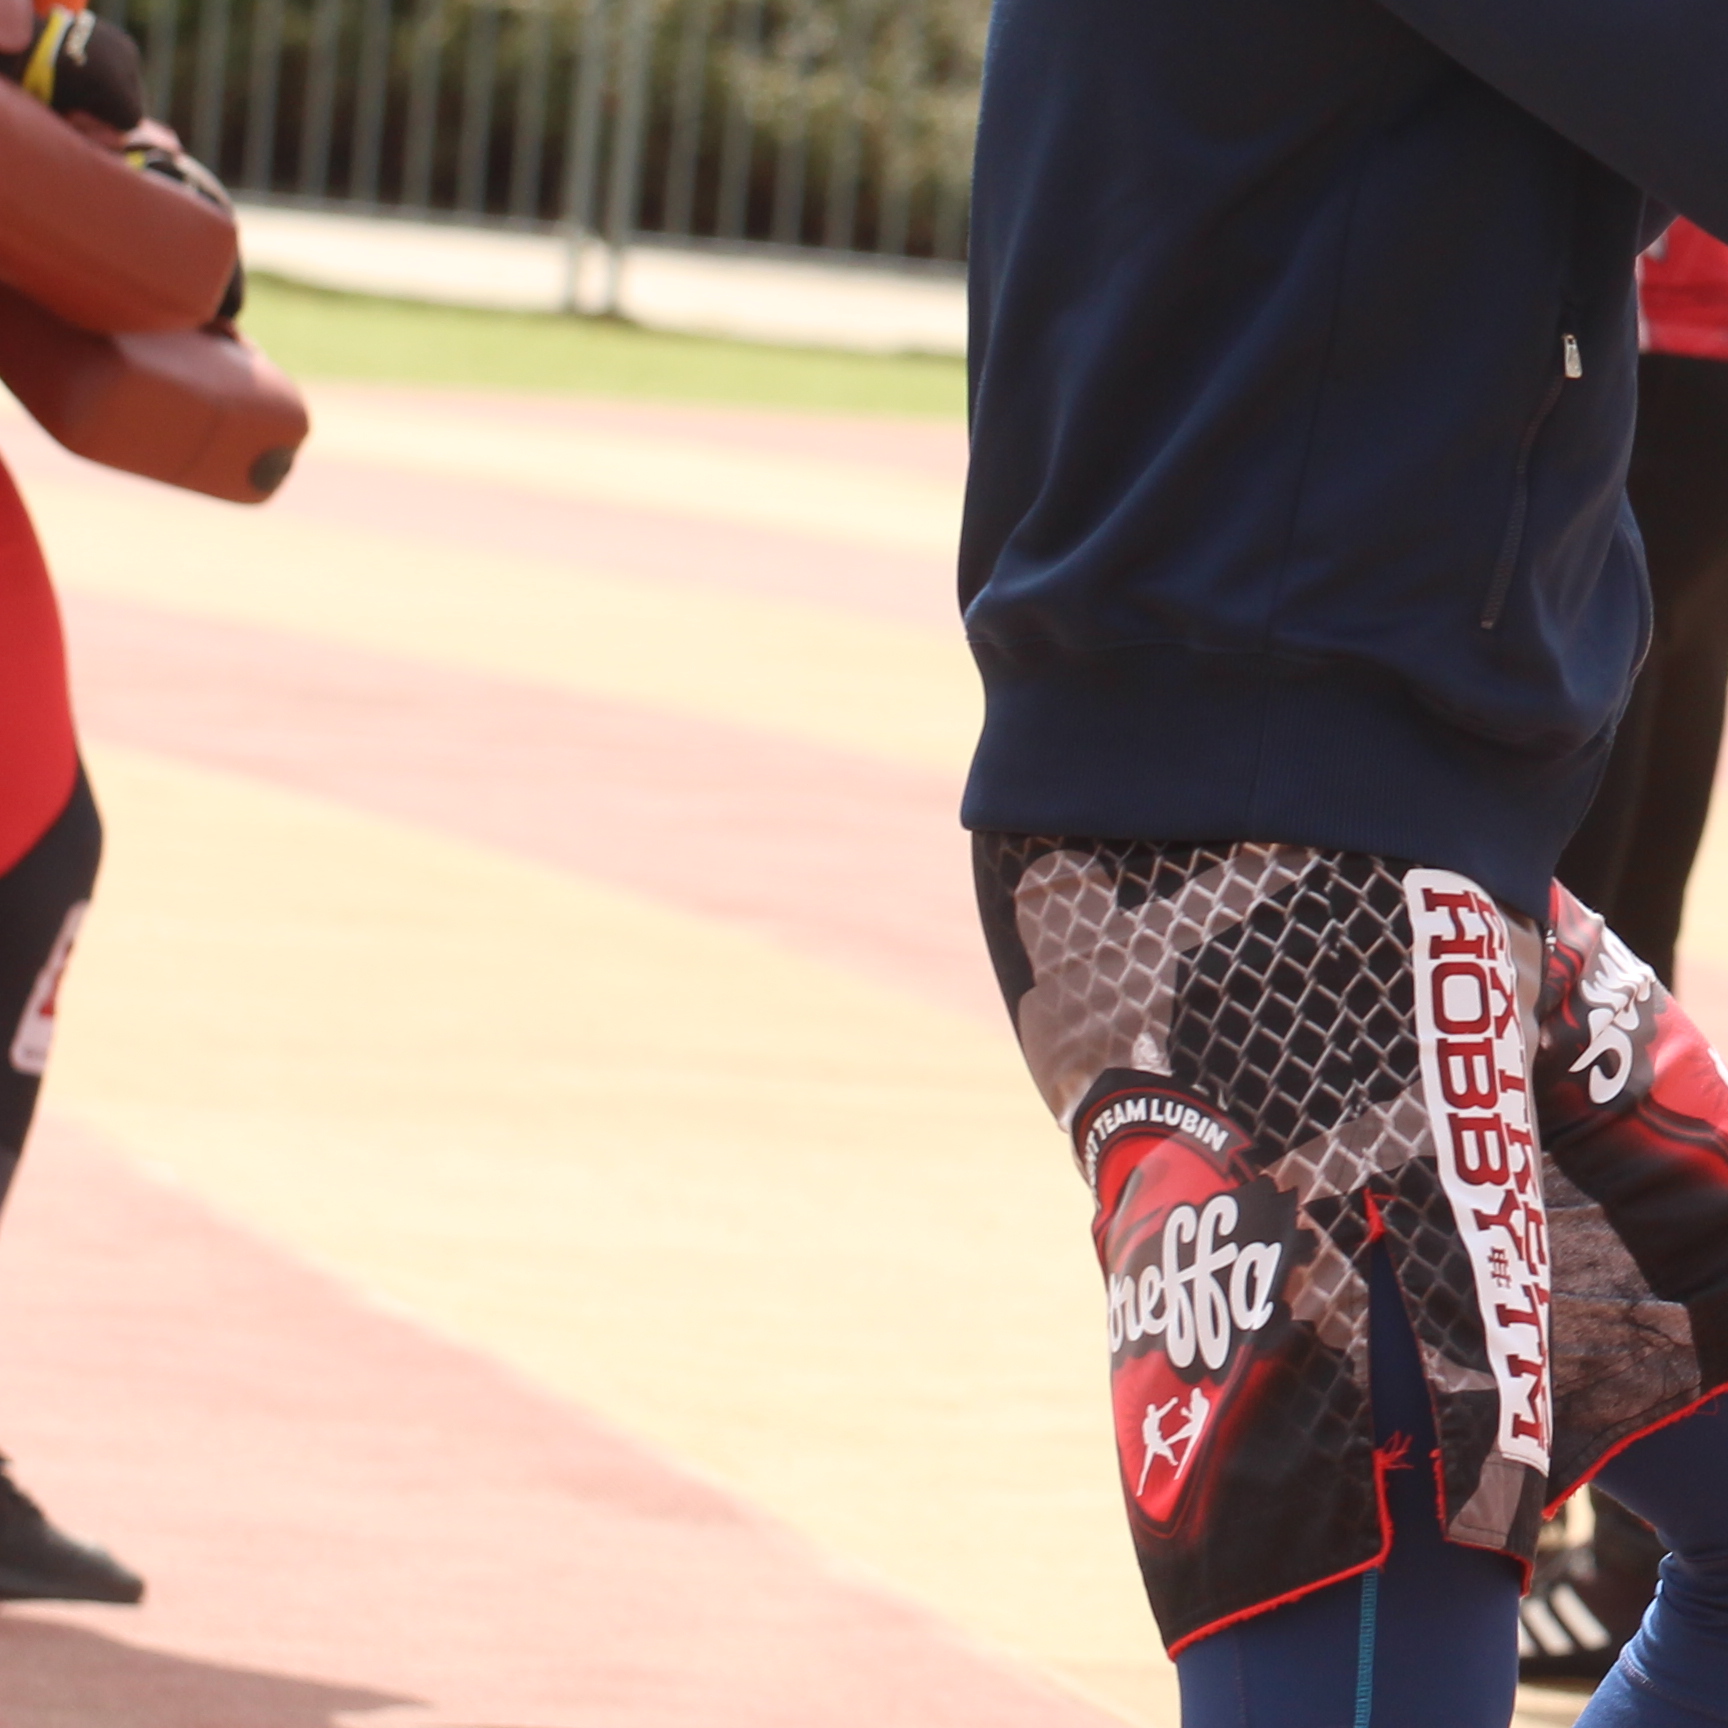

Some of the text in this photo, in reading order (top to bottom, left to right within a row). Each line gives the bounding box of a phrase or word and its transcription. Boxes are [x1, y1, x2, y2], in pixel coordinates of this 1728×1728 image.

[1092, 1097, 1229, 1152] TEAM LUBIN
[1421, 888, 1525, 1261] HOBBY
